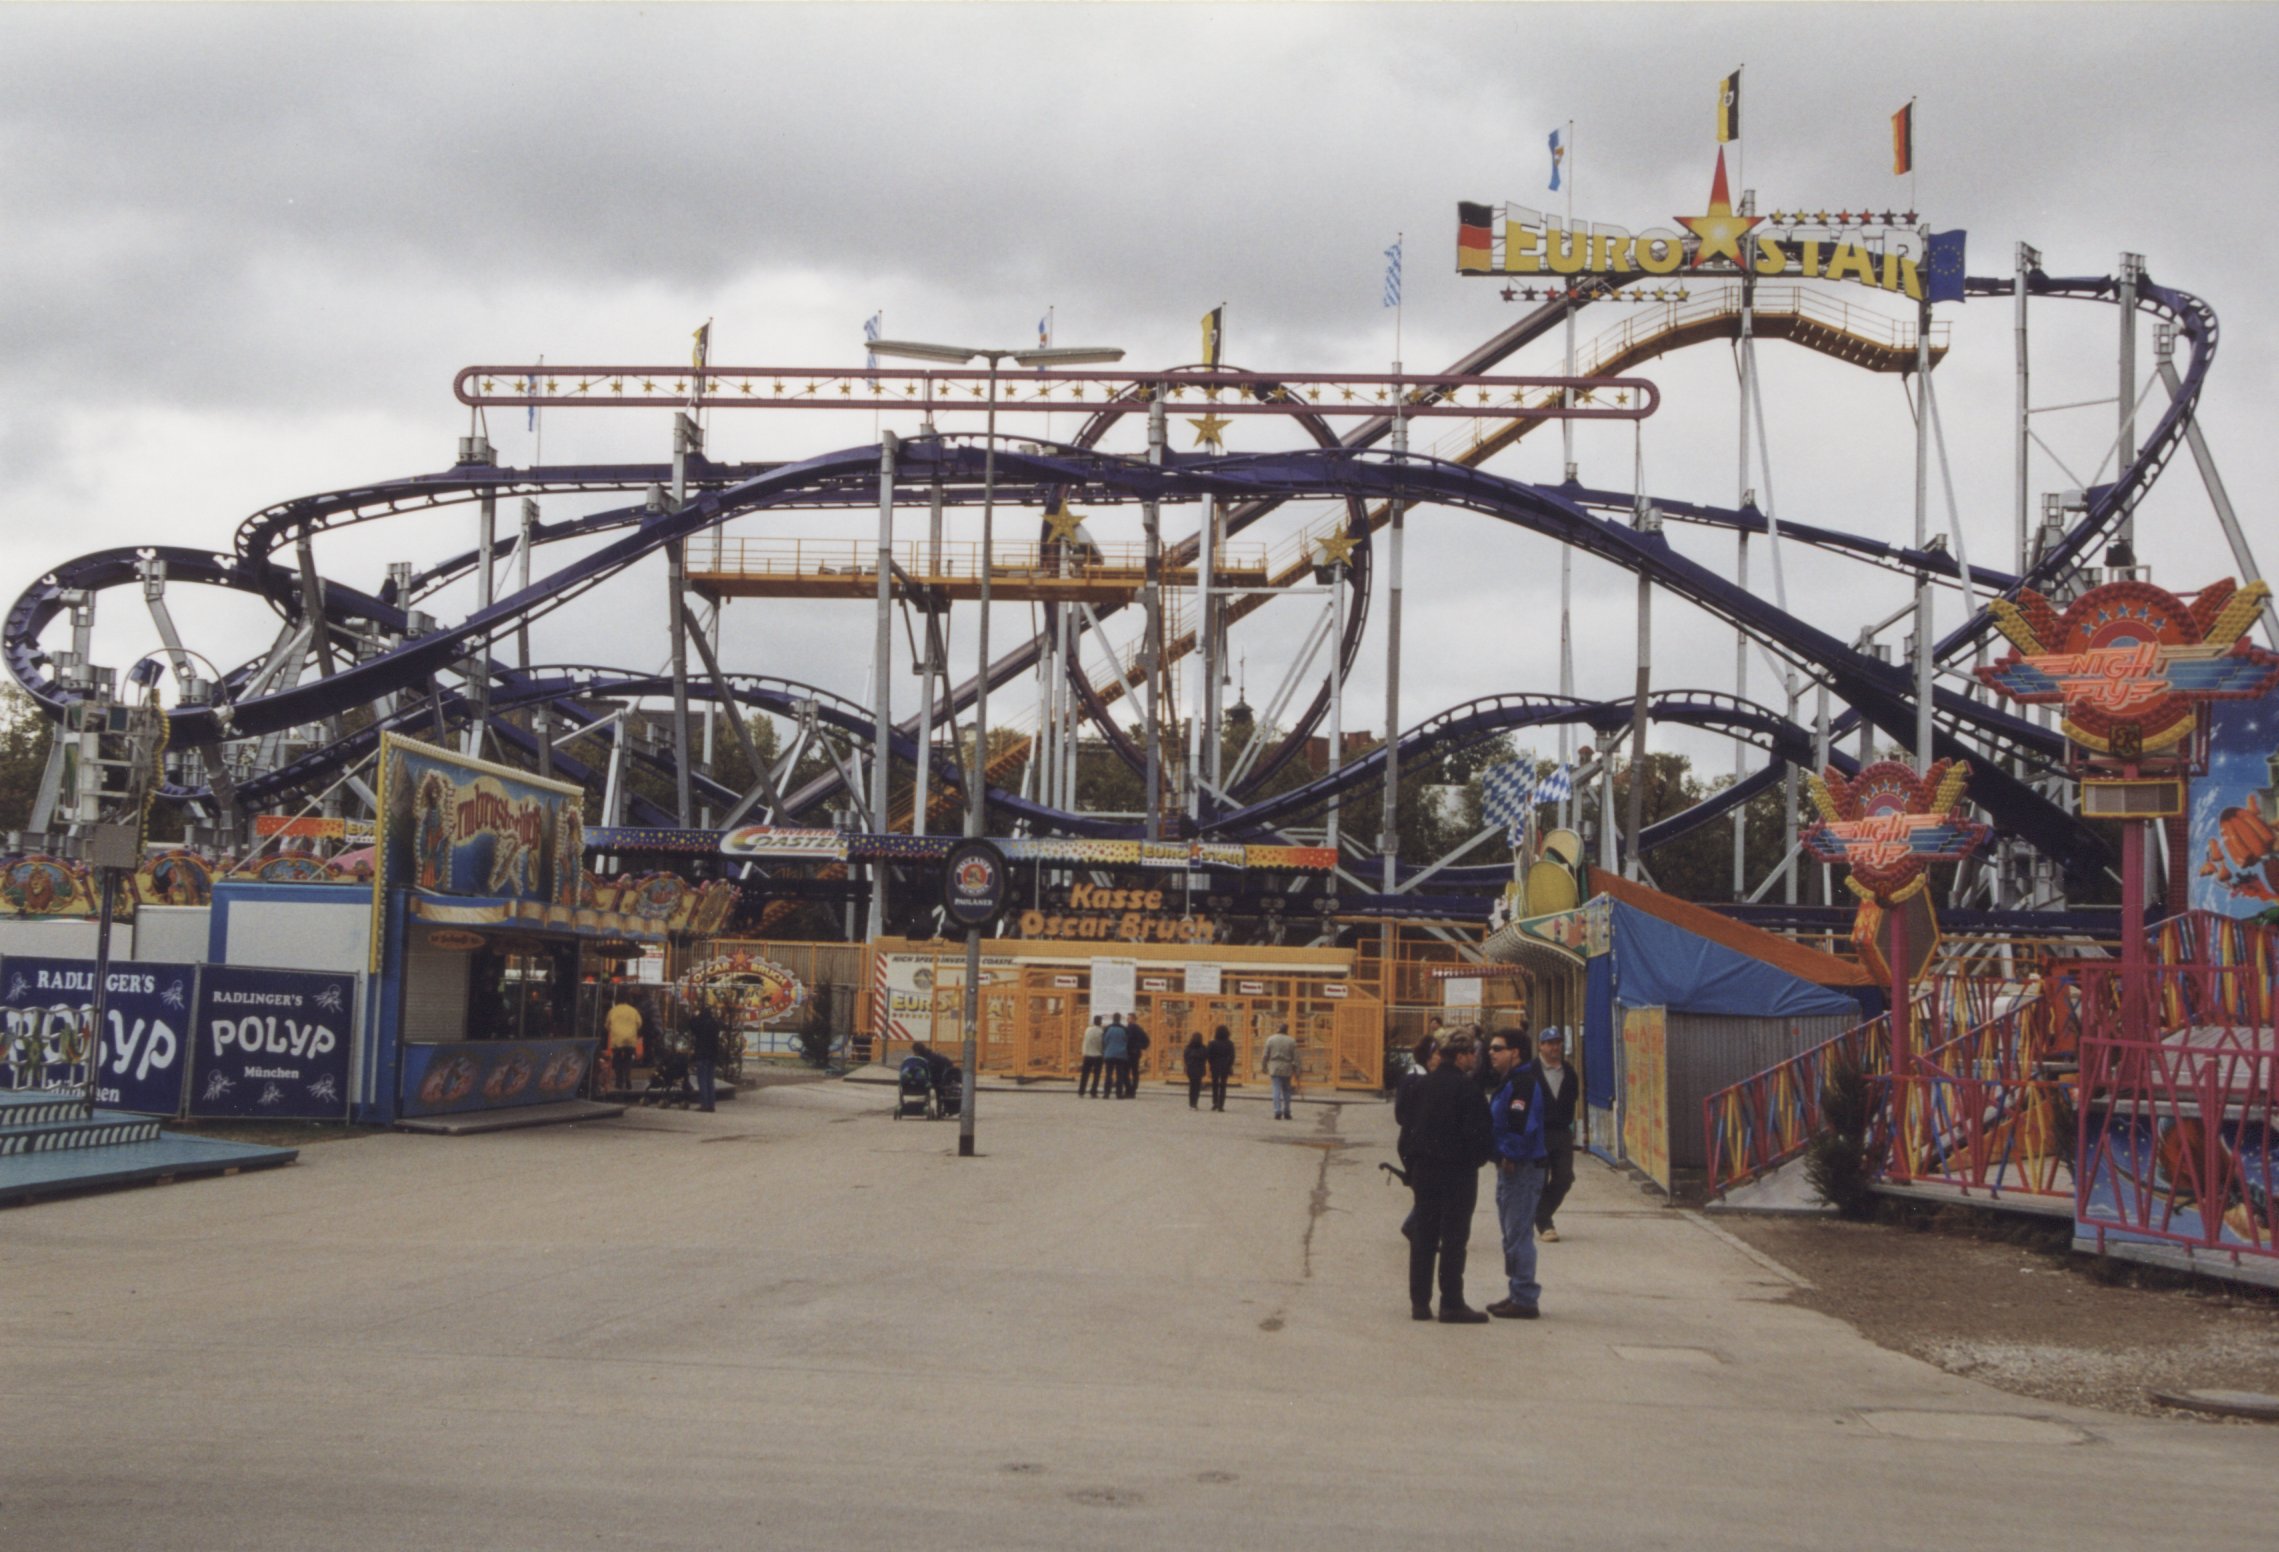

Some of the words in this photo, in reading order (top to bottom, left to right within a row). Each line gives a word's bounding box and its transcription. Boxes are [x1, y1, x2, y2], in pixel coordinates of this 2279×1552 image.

[1505, 200, 1684, 275] EURO
[1756, 227, 1925, 300] STAR
[1144, 845, 1189, 860] EURO
[1201, 847, 1243, 866] STAR
[1069, 883, 1164, 910] Kasse
[1020, 909, 1114, 938] Oscar
[1118, 912, 1215, 940] Bruch
[915, 955, 938, 963] SPEE
[37, 970, 155, 994] RADLIGER'S
[213, 991, 304, 1007] RADLINGER'S
[244, 1066, 300, 1080] München
